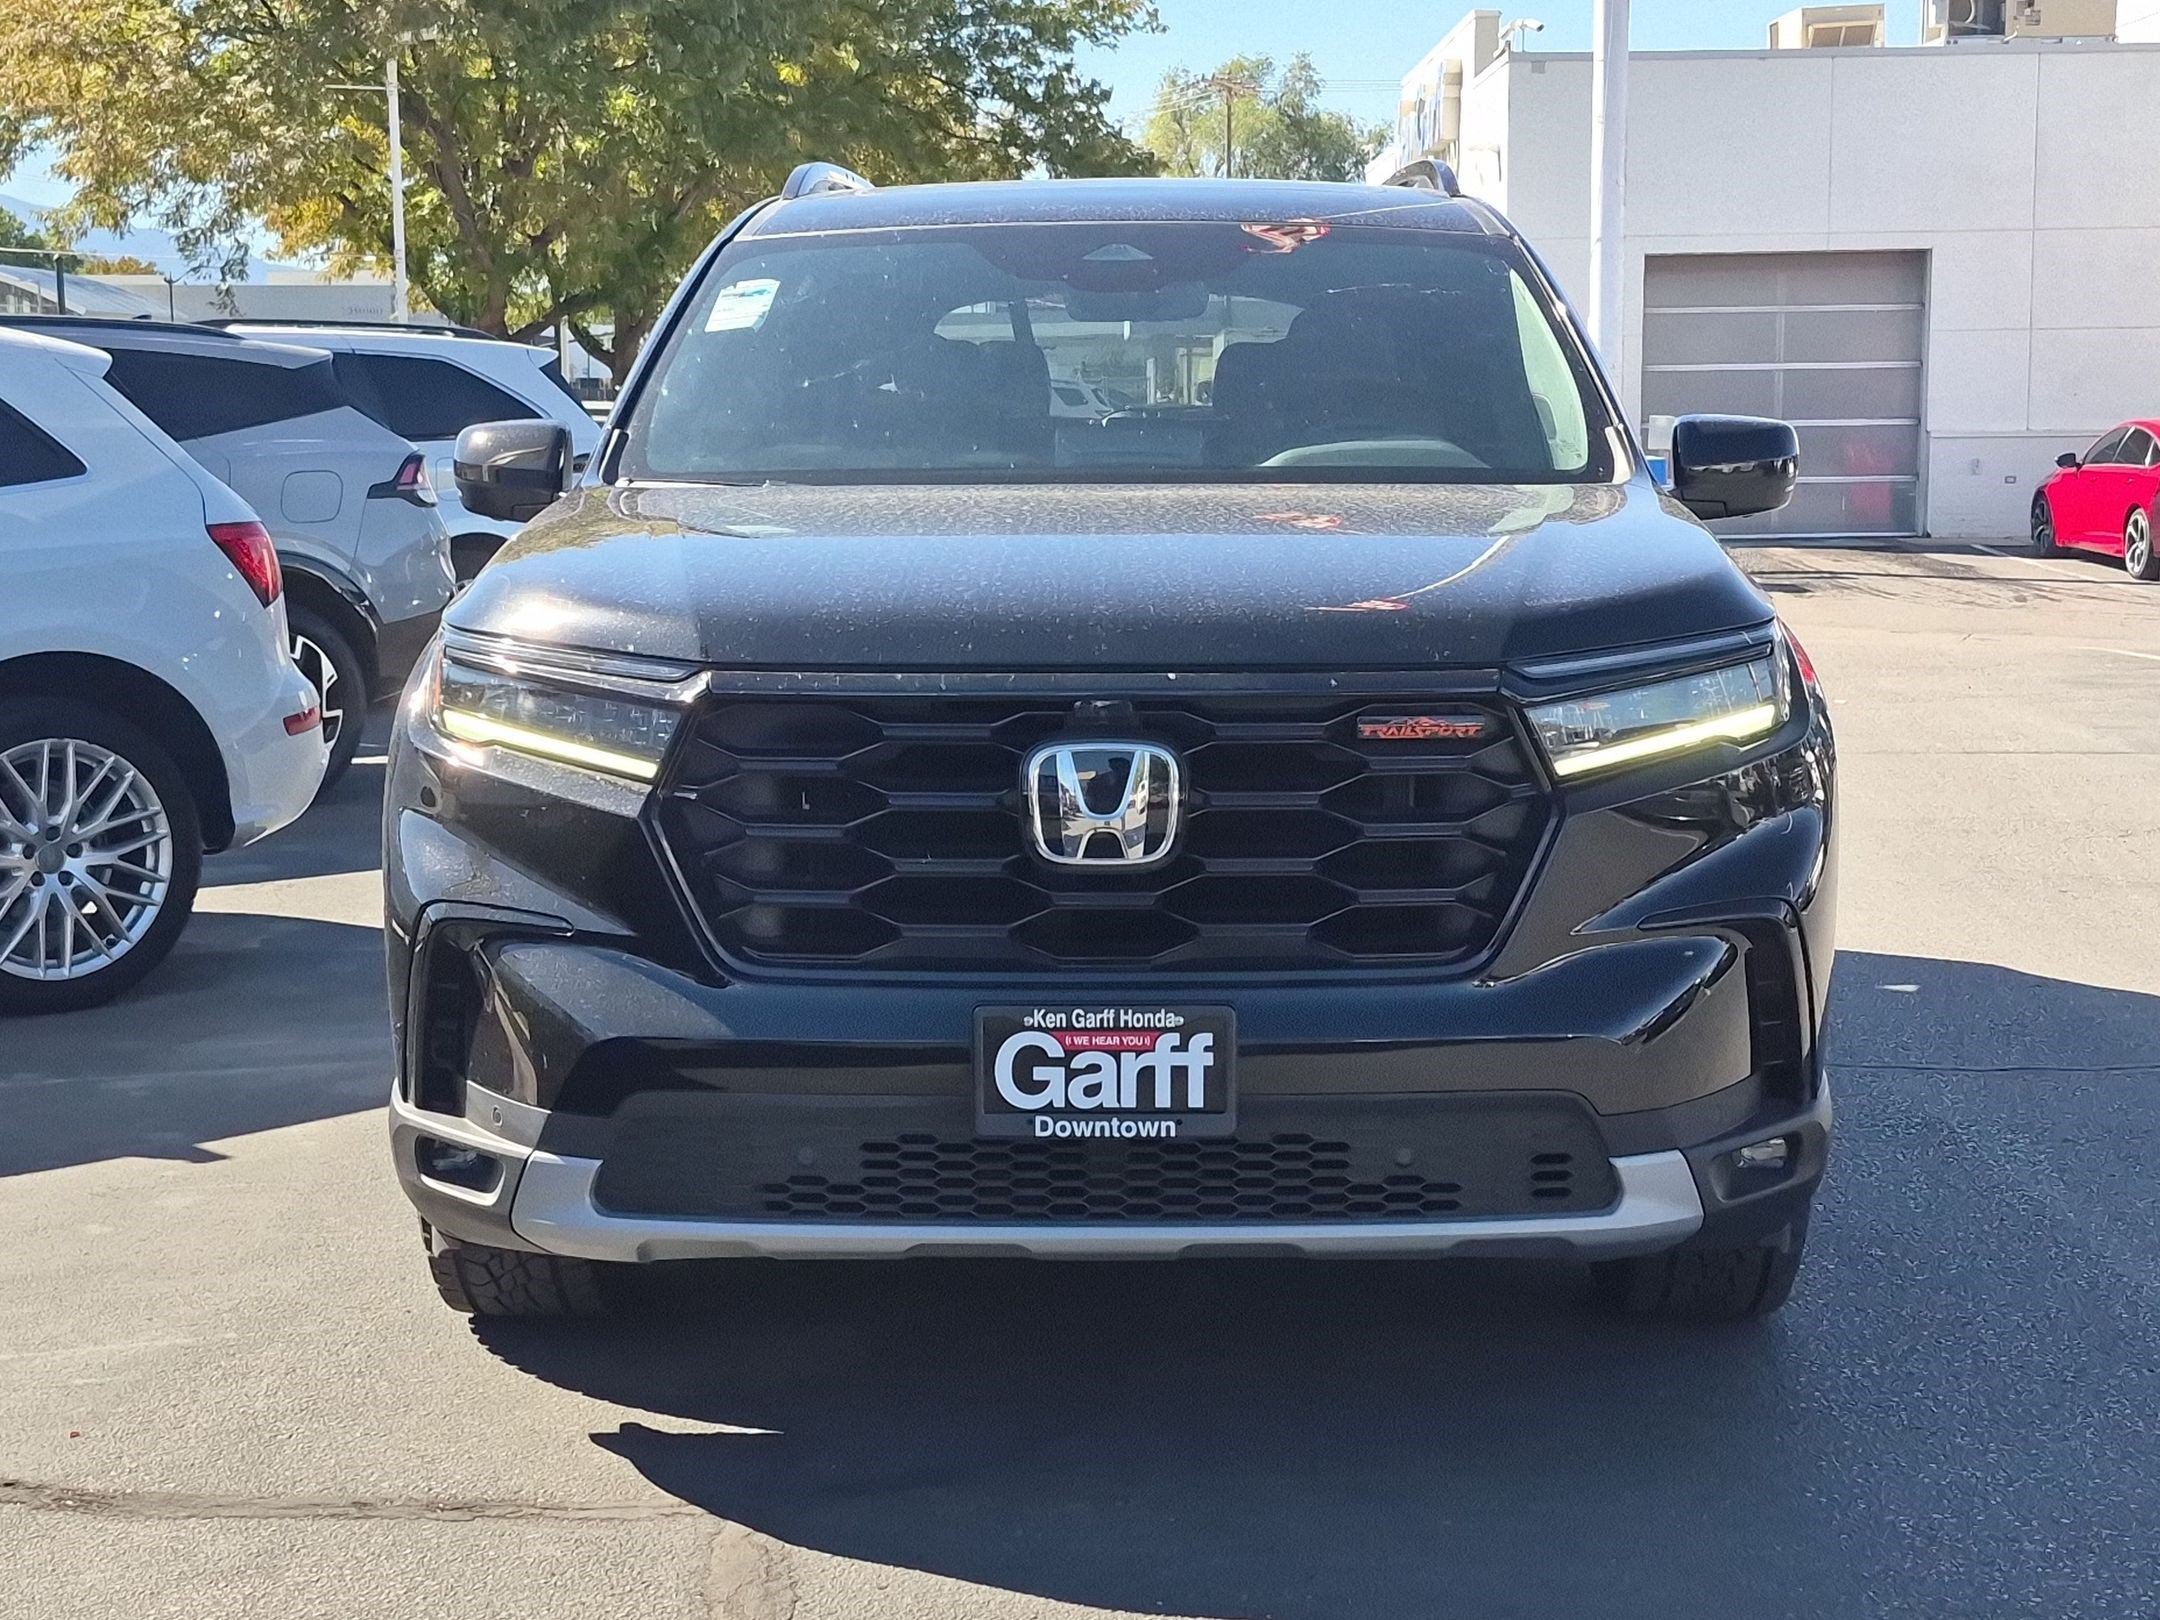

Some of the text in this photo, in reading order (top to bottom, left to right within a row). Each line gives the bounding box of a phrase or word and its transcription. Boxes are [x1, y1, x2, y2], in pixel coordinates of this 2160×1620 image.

[1033, 1008, 1176, 1029] Ken Garff Honda
[1073, 1035, 1144, 1046] WE HEAR YOU
[994, 1031, 1214, 1109] Garff
[1034, 1116, 1176, 1138] Downtown
